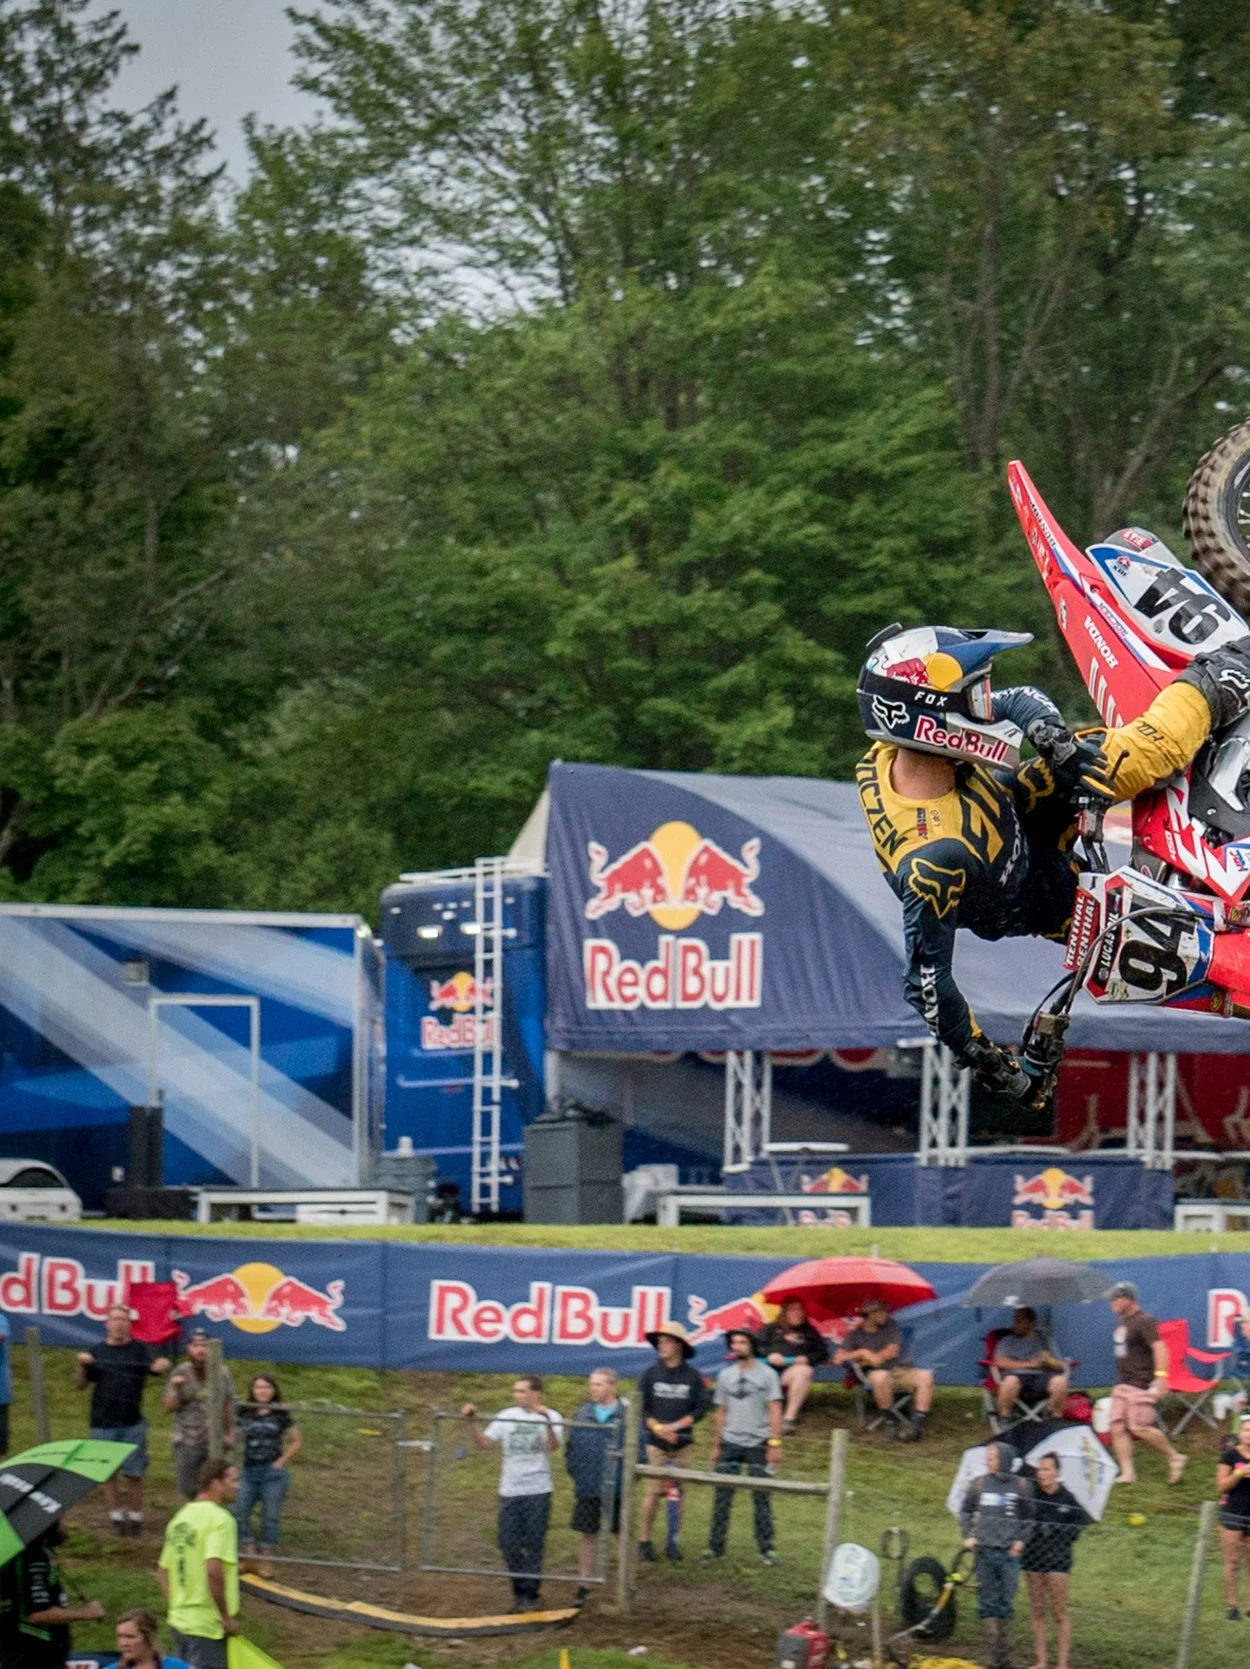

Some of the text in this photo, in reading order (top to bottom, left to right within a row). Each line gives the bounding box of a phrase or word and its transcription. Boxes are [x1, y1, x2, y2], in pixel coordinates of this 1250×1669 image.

[1133, 567, 1232, 646] 94
[1083, 615, 1119, 670] HONDA
[914, 691, 948, 707] FOX
[1066, 894, 1085, 967] RENTHAL
[1100, 932, 1115, 967] LUCAS
[1118, 894, 1197, 996] 94
[584, 931, 763, 1010] Red Bull
[428, 1279, 552, 1344] Red
